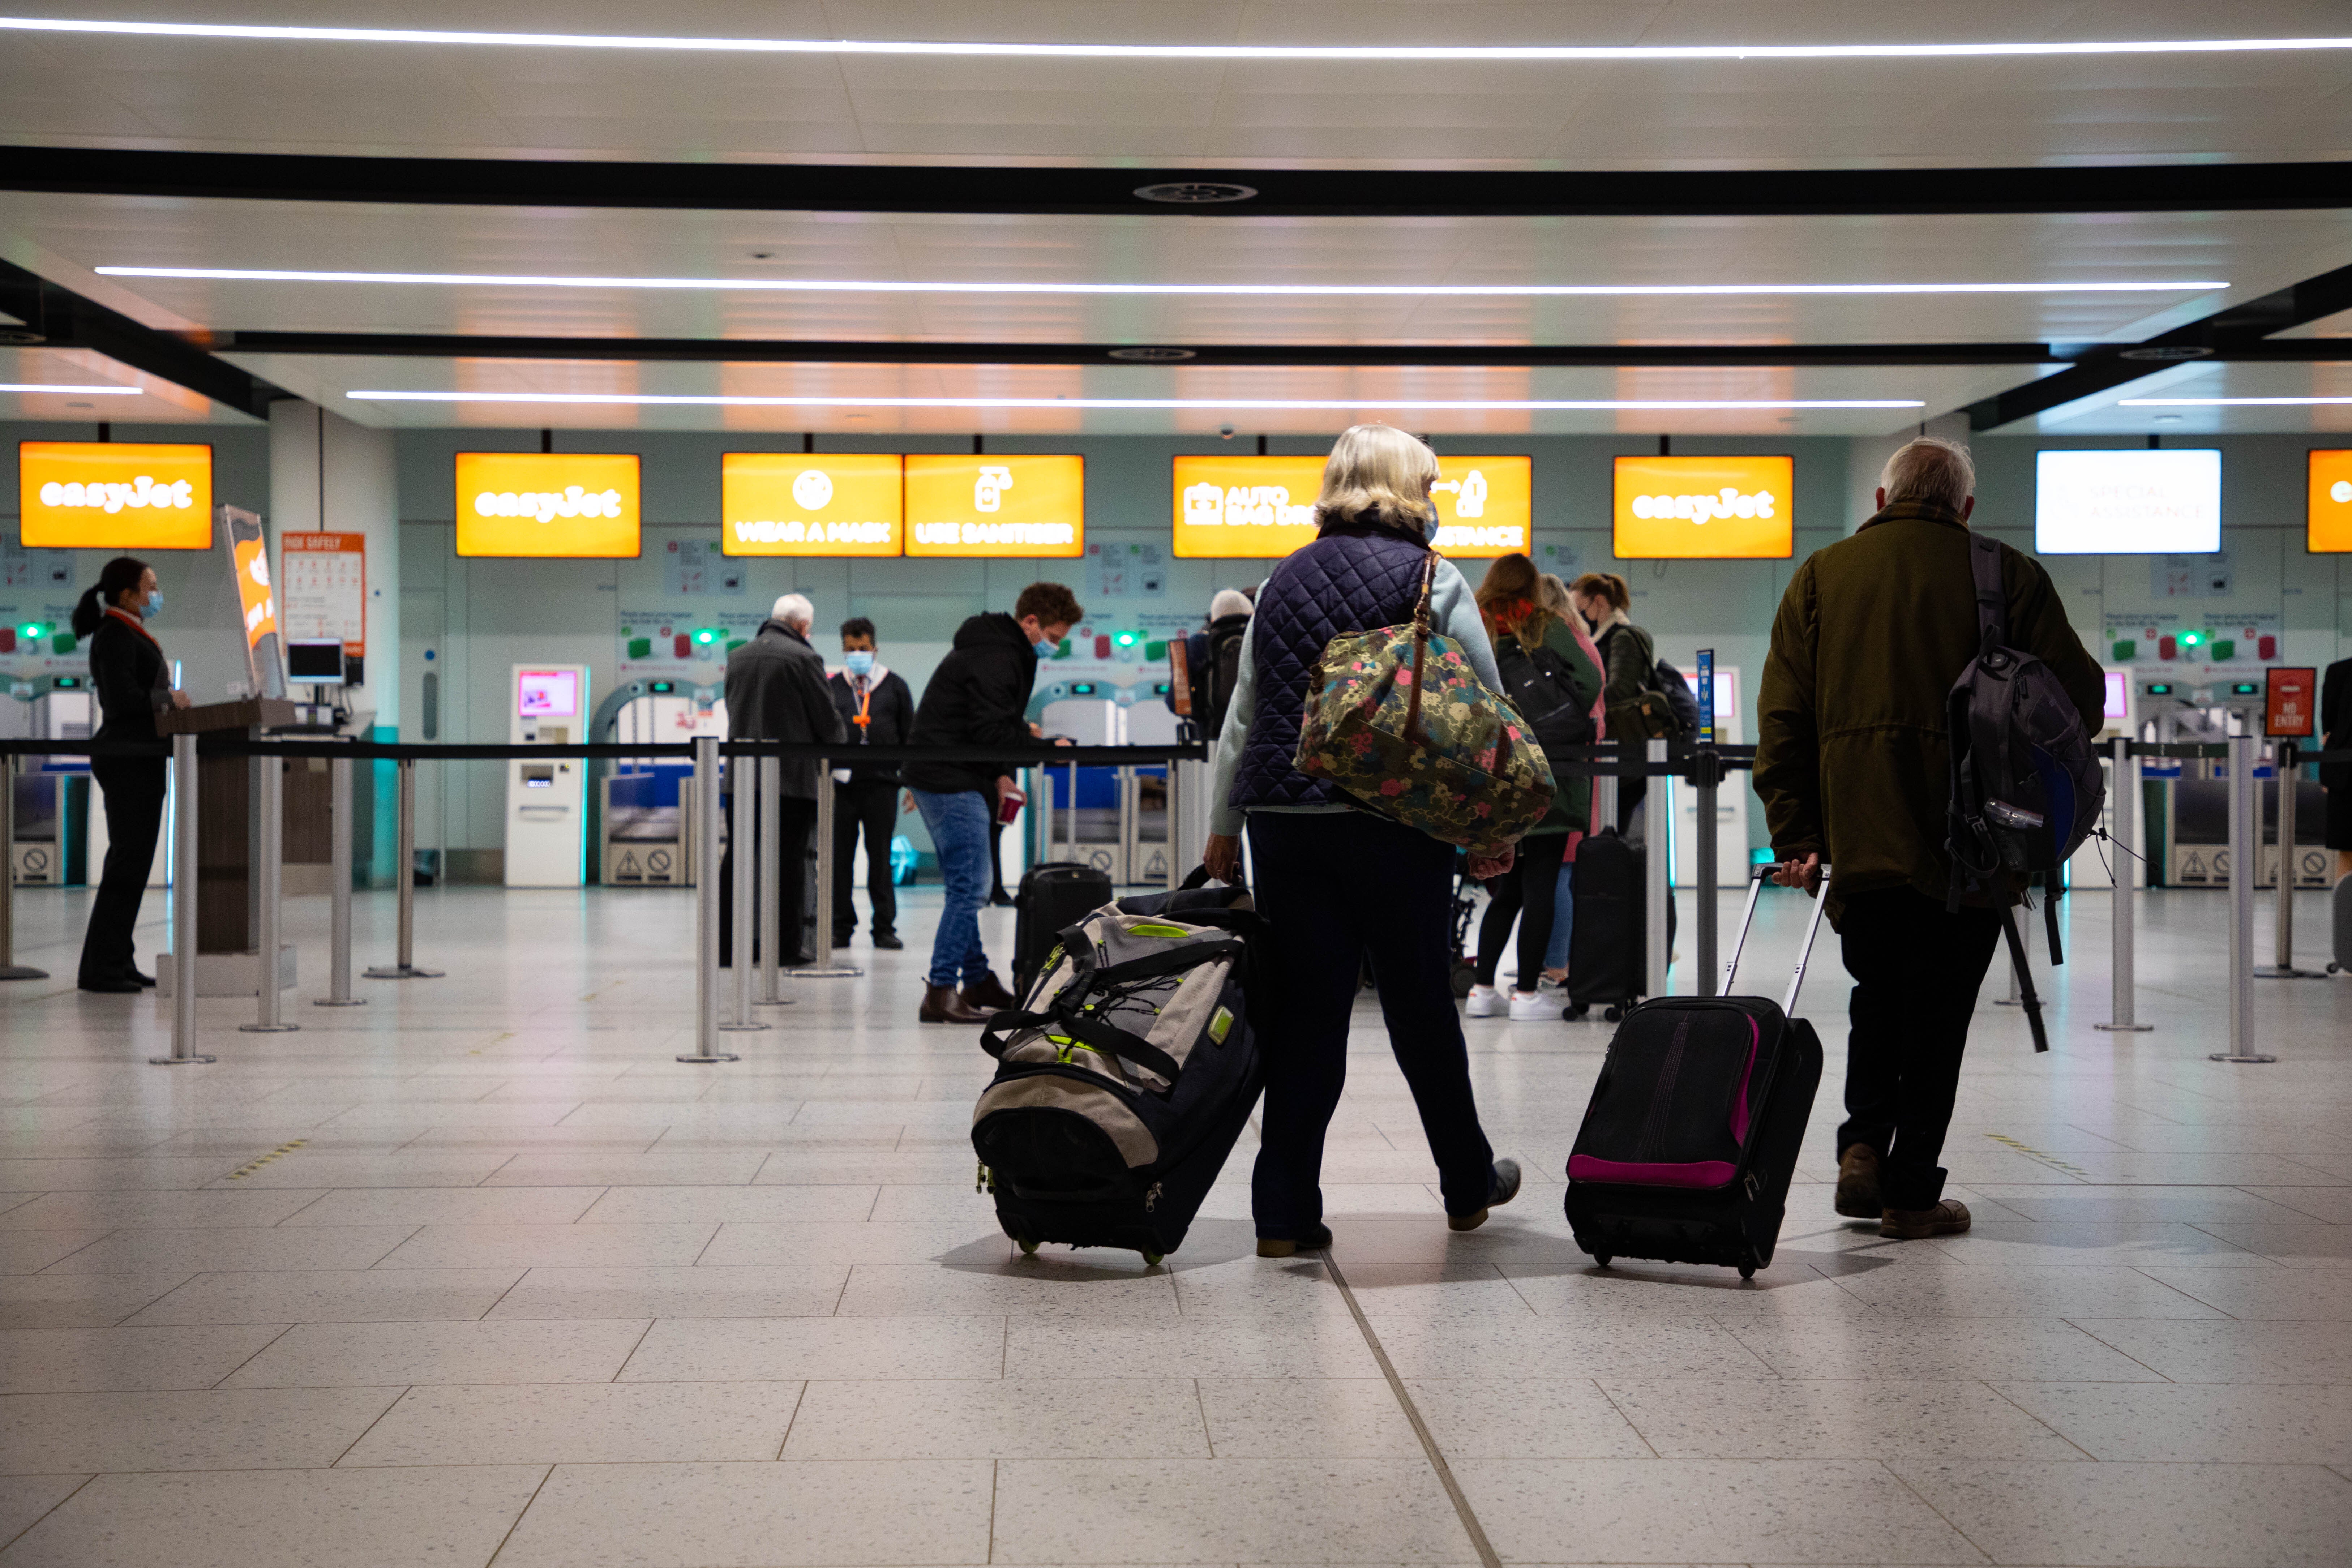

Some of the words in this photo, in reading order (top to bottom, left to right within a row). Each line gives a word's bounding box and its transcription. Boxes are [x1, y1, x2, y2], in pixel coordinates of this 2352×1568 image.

[40, 476, 192, 513] easyJet
[1225, 486, 1289, 506] AUTO
[2090, 485, 2168, 498] SPECIAL
[474, 485, 621, 523] easyJet
[1632, 487, 1775, 525] easyJet
[2090, 504, 2206, 519] ASSISTANCE
[1225, 505, 1274, 526] BAG
[734, 520, 805, 543] WEAR
[806, 521, 826, 543] A
[827, 521, 891, 543] MASK
[914, 522, 960, 544] USE
[961, 522, 1074, 544] SANITISER
[1429, 525, 1524, 547] ISTANCE
[2283, 702, 2297, 715] NO
[2274, 714, 2305, 728] ENTRY
